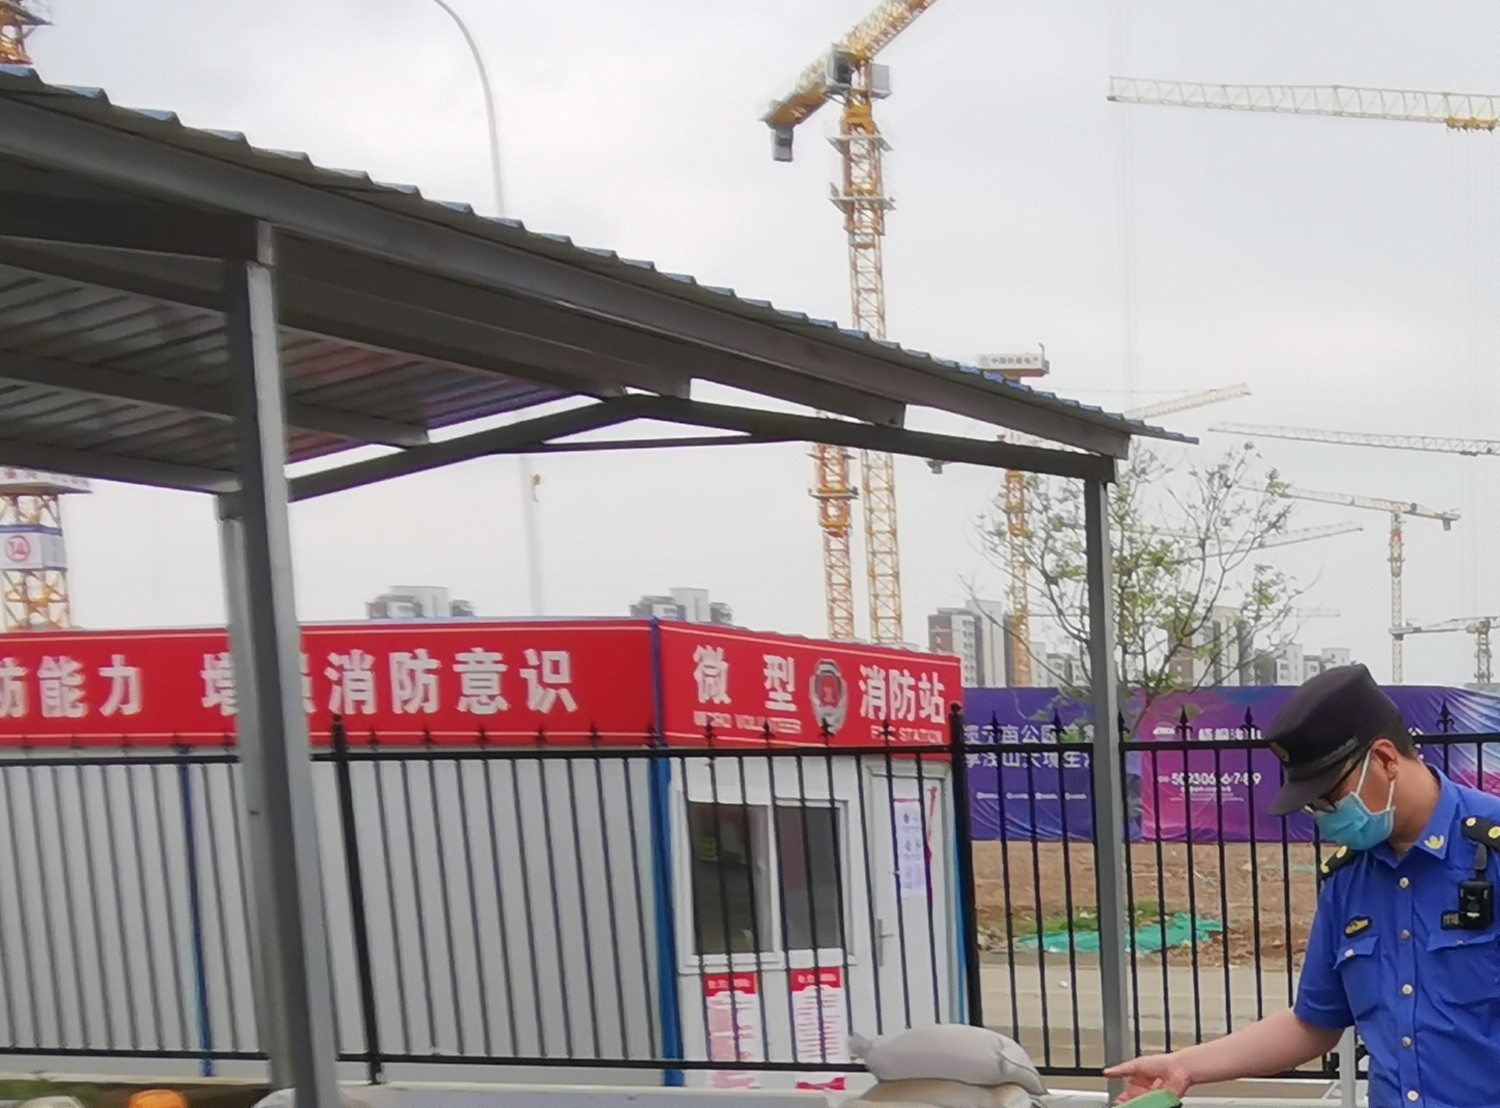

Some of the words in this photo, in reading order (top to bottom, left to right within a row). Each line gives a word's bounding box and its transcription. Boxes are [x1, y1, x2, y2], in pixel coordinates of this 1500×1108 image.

[200, 647, 578, 717] 增消防意识
[693, 645, 797, 712] 微型
[858, 664, 945, 724] 消防站
